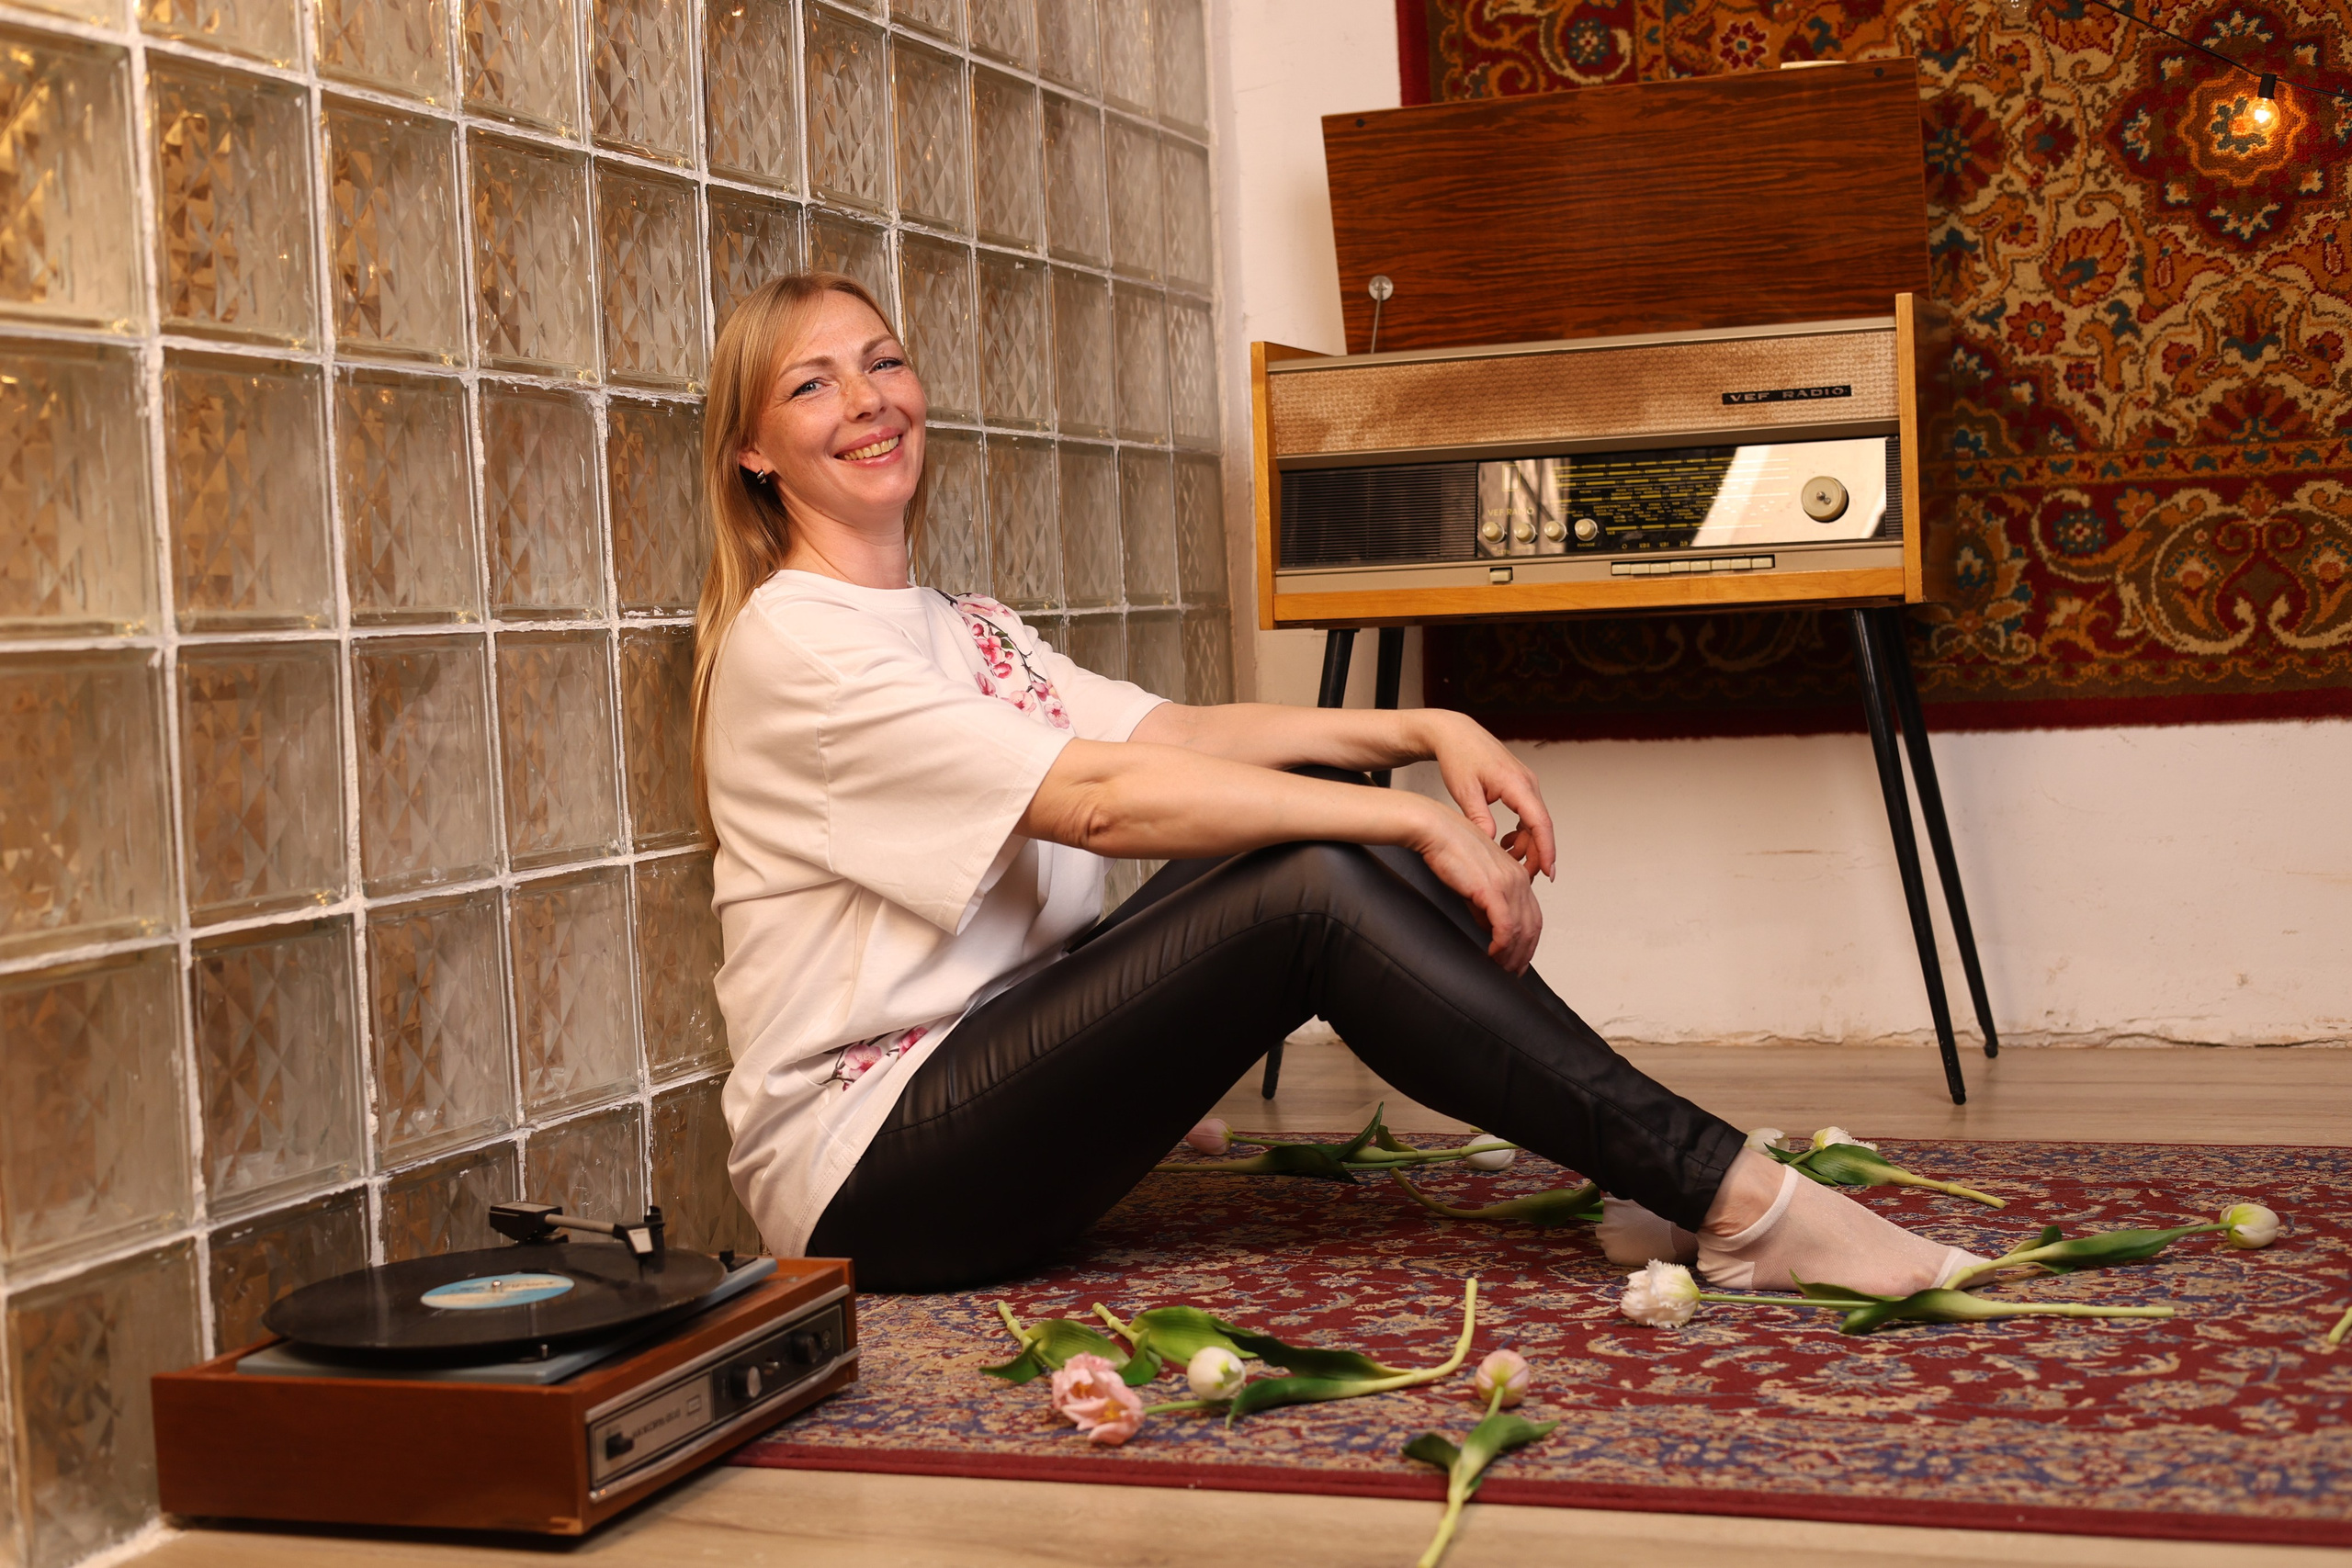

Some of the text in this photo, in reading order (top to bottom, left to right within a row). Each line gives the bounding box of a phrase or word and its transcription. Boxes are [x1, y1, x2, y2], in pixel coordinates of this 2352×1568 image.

[1729, 387, 1844, 402] VEF RADIO
[1487, 508, 1504, 516] VEF
